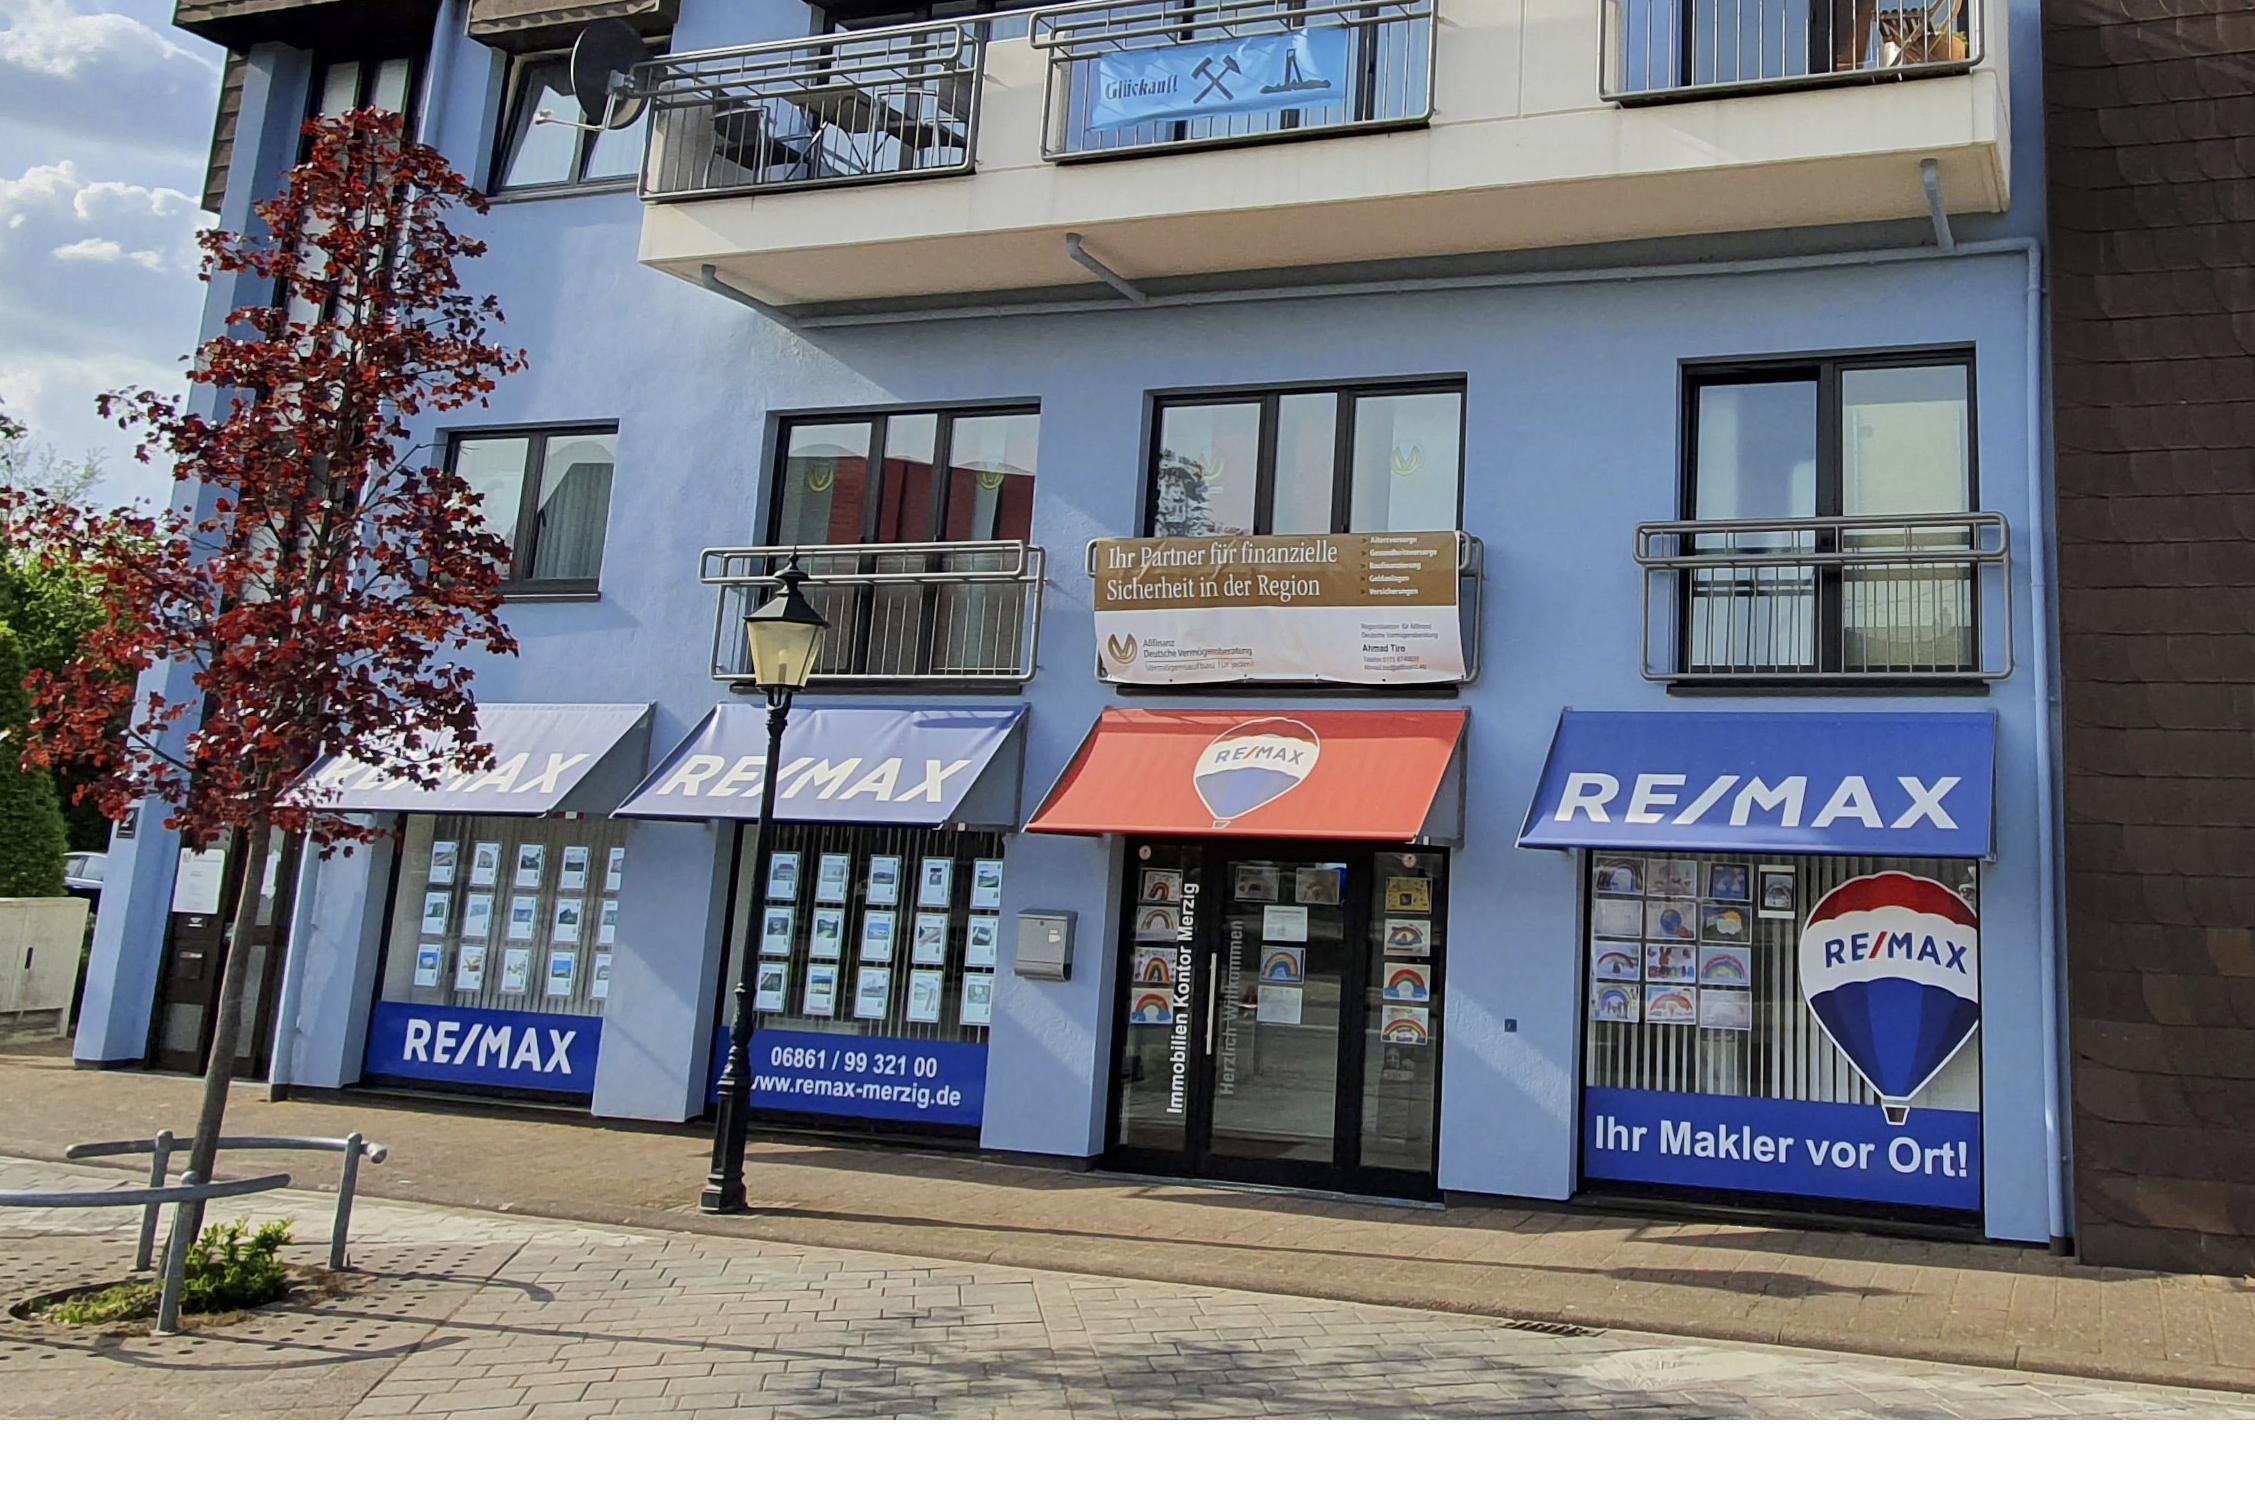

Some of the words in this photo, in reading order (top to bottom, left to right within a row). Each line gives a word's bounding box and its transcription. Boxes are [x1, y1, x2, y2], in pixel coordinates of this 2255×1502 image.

[1104, 74, 1178, 101] Glückauf!
[1108, 546, 1136, 569] Ihr
[1140, 544, 1203, 568] Partner
[1210, 541, 1237, 565] für
[1241, 540, 1338, 564] finanzielle
[1107, 576, 1195, 601] Sicherheit
[1200, 574, 1219, 597] in
[1223, 574, 1252, 597] der
[1257, 574, 1321, 602] Region
[1143, 649, 1177, 658] Deutsche
[1214, 745, 1305, 765] RE/MAX
[655, 754, 973, 803] RE/MAX
[1553, 772, 1963, 830] RE/MAX
[120, 810, 135, 827] 2
[1177, 883, 1199, 941] Merzig
[1173, 944, 1192, 1008] Kontor
[1824, 931, 1967, 975] RE/MAX
[403, 1018, 577, 1074] RE/MAX
[771, 1046, 826, 1069] 06861
[831, 1050, 840, 1071] /
[844, 1051, 868, 1073] 99
[873, 1054, 907, 1076] 321
[914, 1056, 937, 1078] 00
[1166, 1013, 1189, 1113] Immobilien
[1220, 1024, 1238, 1095] Herzlich
[1595, 1115, 1647, 1152] Ihr
[1659, 1118, 1794, 1163] Makler
[1805, 1138, 1875, 1170] vor
[1888, 1137, 1968, 1178] Ort!
